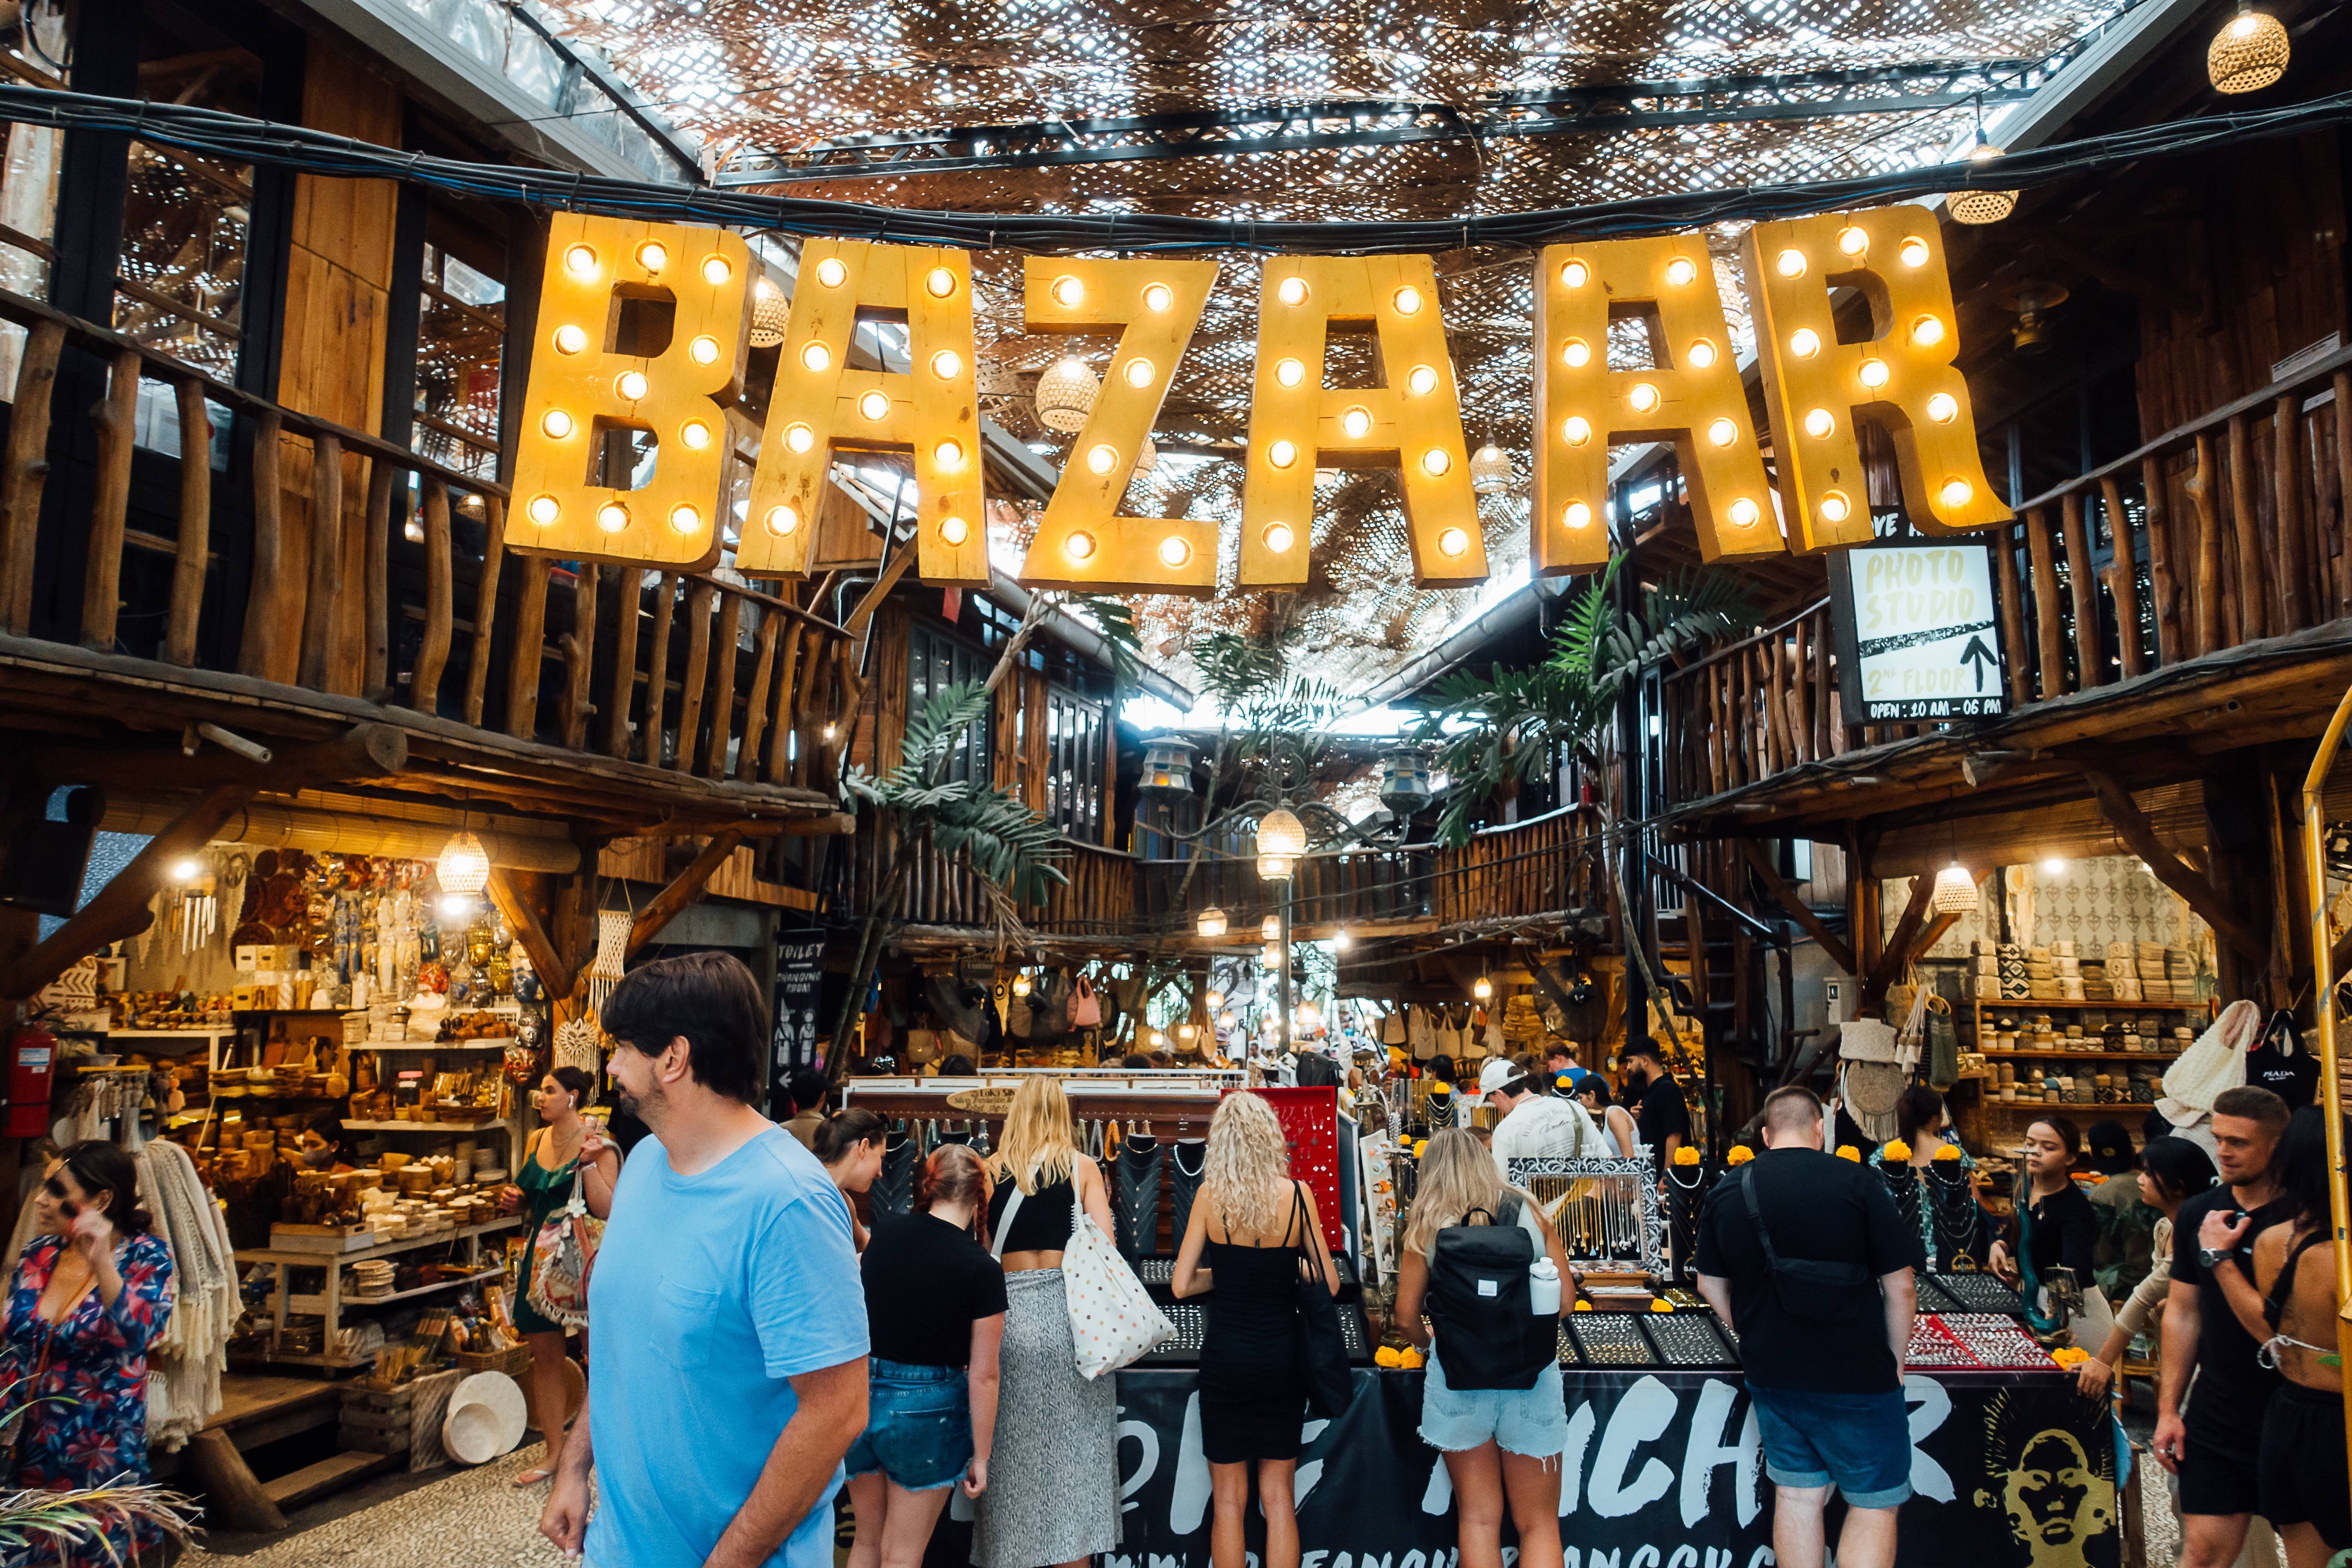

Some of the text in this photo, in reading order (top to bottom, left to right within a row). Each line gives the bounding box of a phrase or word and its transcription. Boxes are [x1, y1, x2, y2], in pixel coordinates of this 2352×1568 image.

[504, 205, 2016, 593] BAZAAR
[1867, 550, 1964, 594] PHOTO
[1867, 587, 1974, 630] STUDIO
[1904, 667, 1967, 694] FLOOR
[1910, 701, 1926, 717] 10
[1930, 701, 1950, 716] AM
[1963, 699, 1979, 714] 06
[1984, 698, 2001, 714] PM
[778, 942, 825, 960] TOILET
